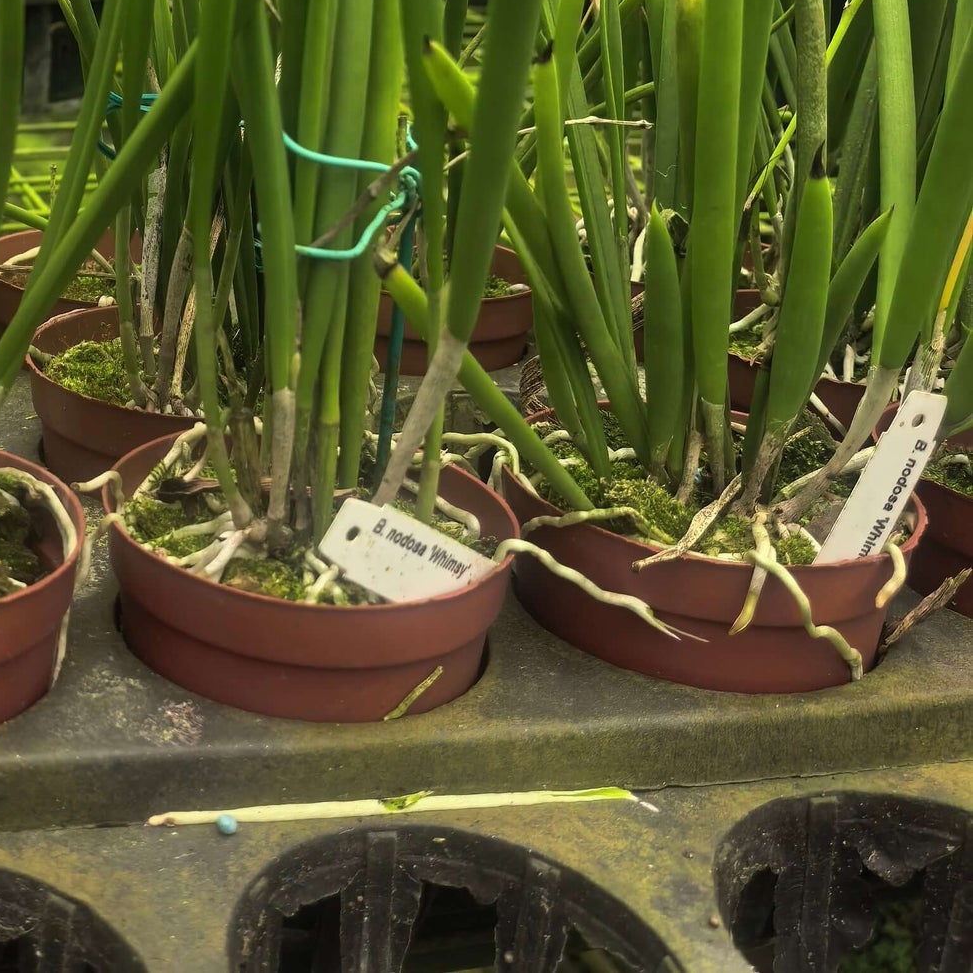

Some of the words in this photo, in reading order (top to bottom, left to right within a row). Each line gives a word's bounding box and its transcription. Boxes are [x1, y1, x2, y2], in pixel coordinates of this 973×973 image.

[912, 439, 928, 453] B.
[883, 458, 917, 512] nodosa
[372, 518, 387, 536] B.
[386, 528, 427, 557] nodosa
